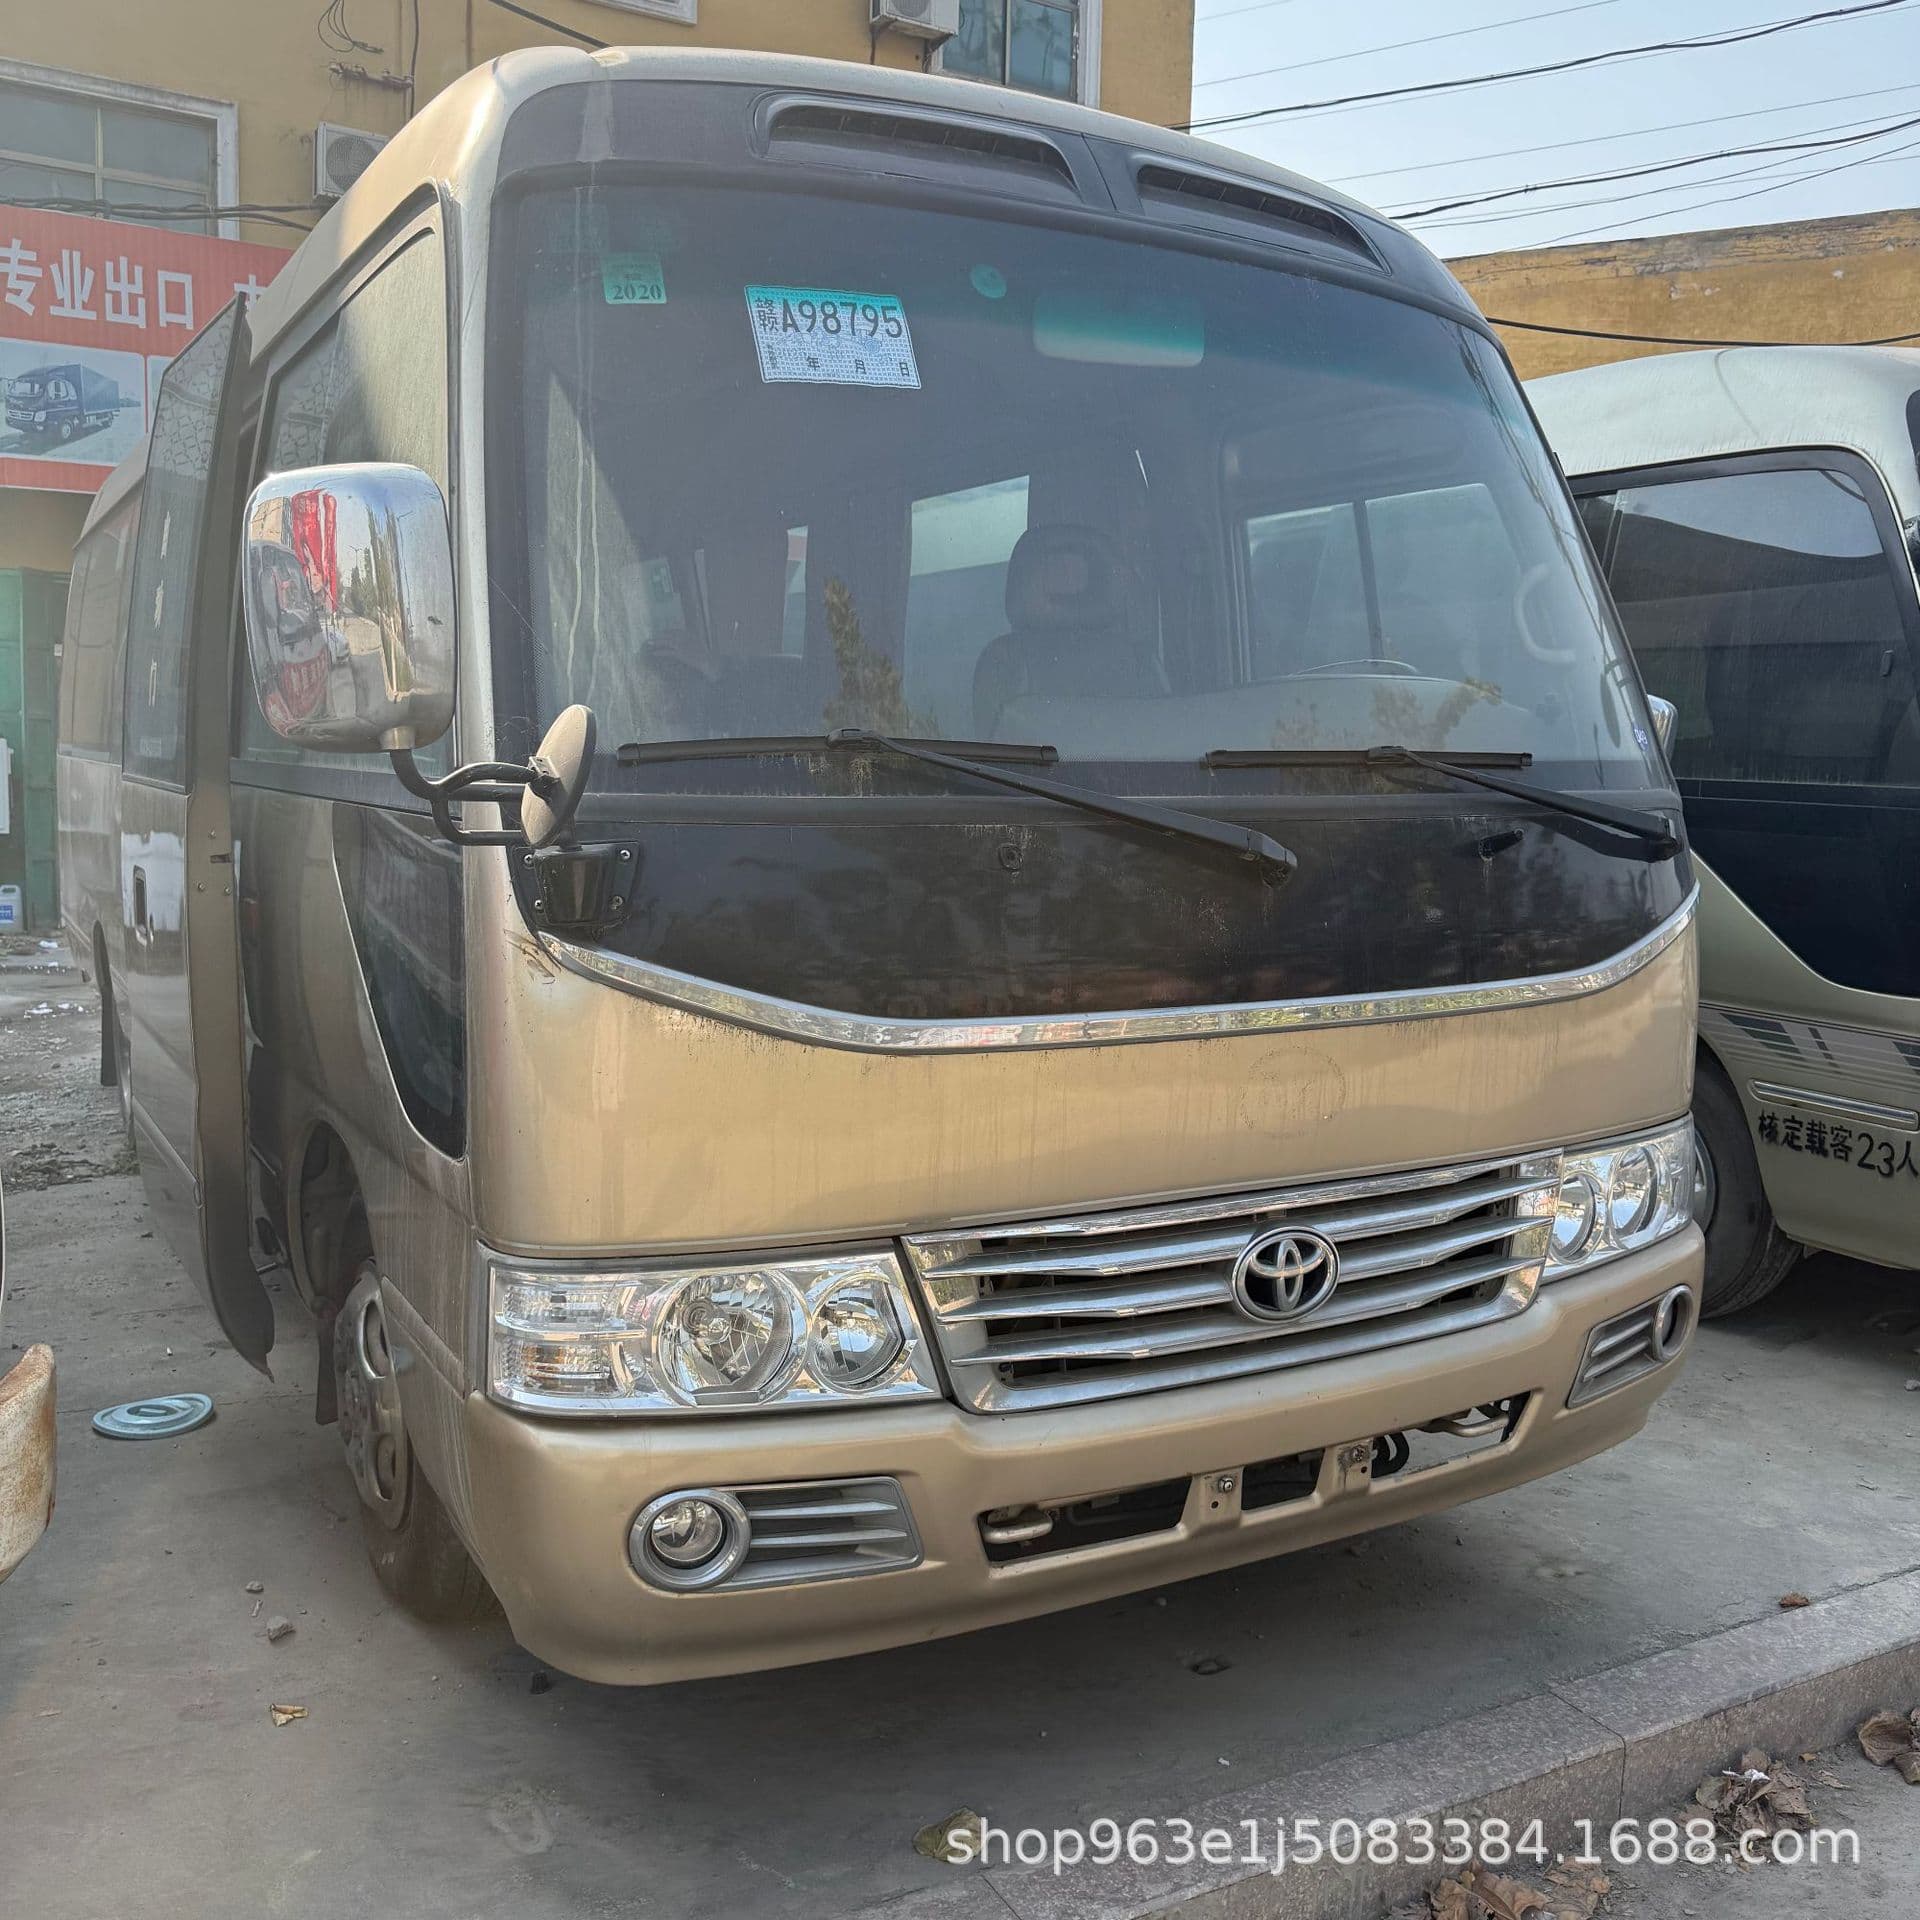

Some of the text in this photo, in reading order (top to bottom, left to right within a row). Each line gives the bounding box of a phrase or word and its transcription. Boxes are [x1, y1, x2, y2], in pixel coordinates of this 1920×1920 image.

[0, 238, 195, 330] 专业出口
[612, 284, 662, 300] 2020
[755, 297, 902, 338] 赣A98795
[855, 359, 867, 374] 月
[900, 362, 910, 377] 日
